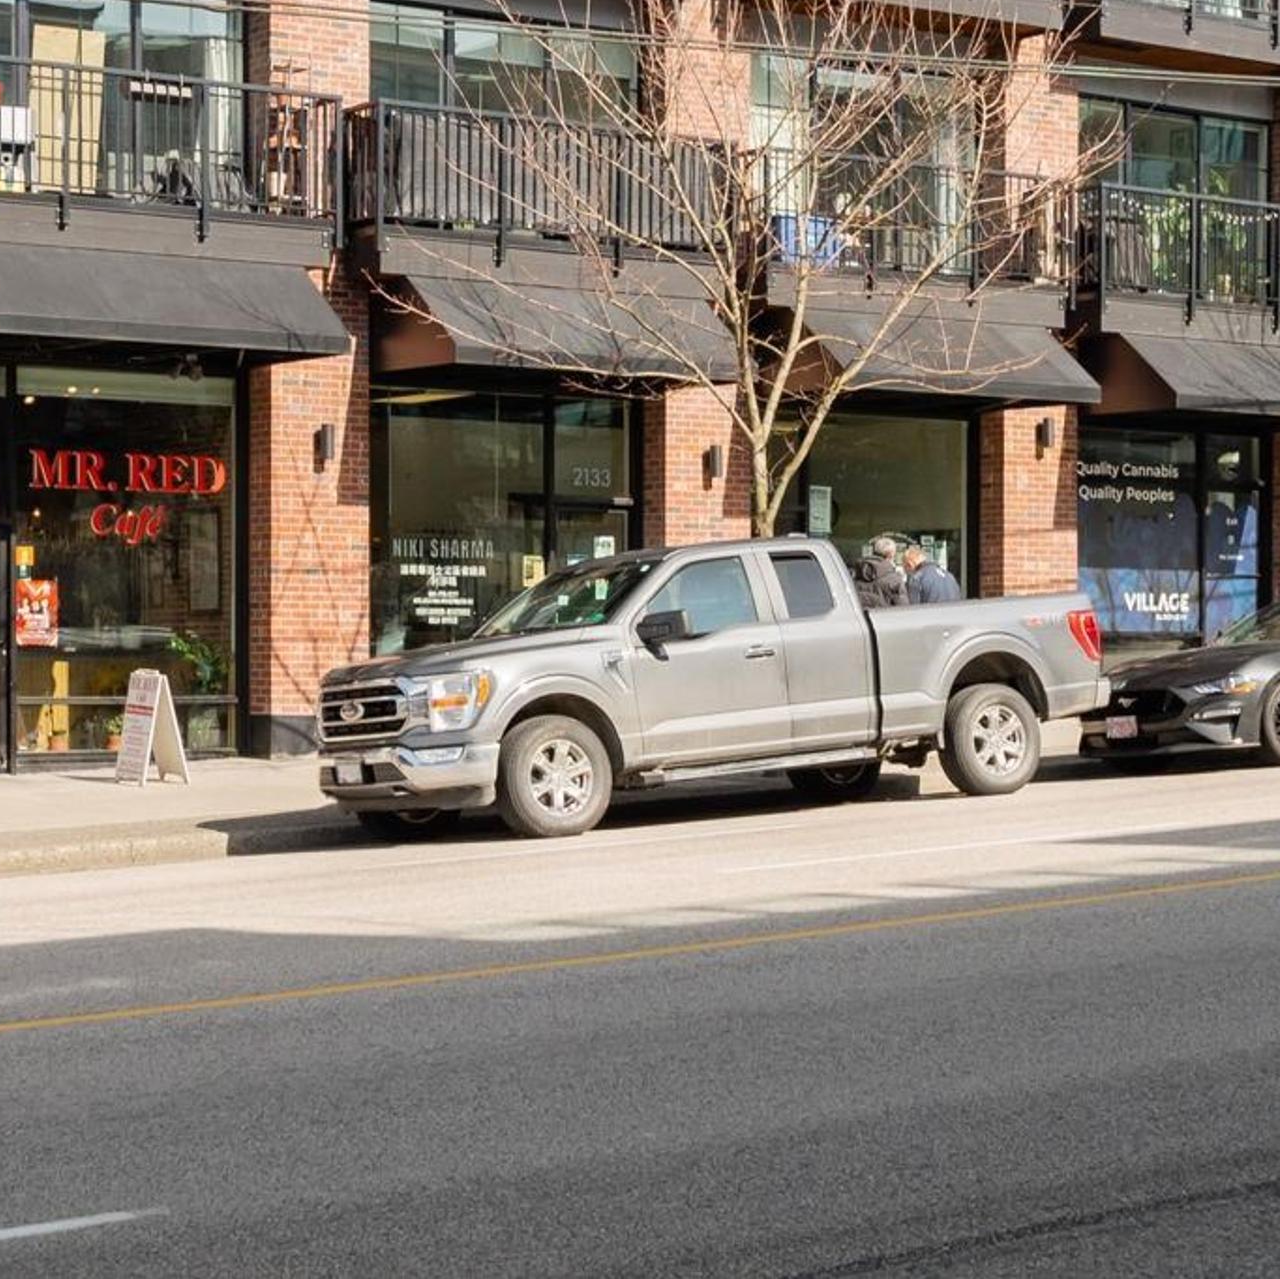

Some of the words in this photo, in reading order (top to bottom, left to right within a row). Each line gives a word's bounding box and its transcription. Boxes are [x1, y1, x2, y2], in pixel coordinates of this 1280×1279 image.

[28, 448, 118, 492] MR.
[125, 451, 228, 494] RED
[573, 467, 612, 487] 2133
[1076, 461, 1119, 478] Quality
[1122, 463, 1179, 479] Cannabis
[1078, 485, 1124, 503] Quality
[1126, 486, 1176, 504] Peoples
[393, 538, 424, 558] NIKI
[430, 538, 494, 559] SHARMA
[1124, 592, 1190, 613] VILLAGE
